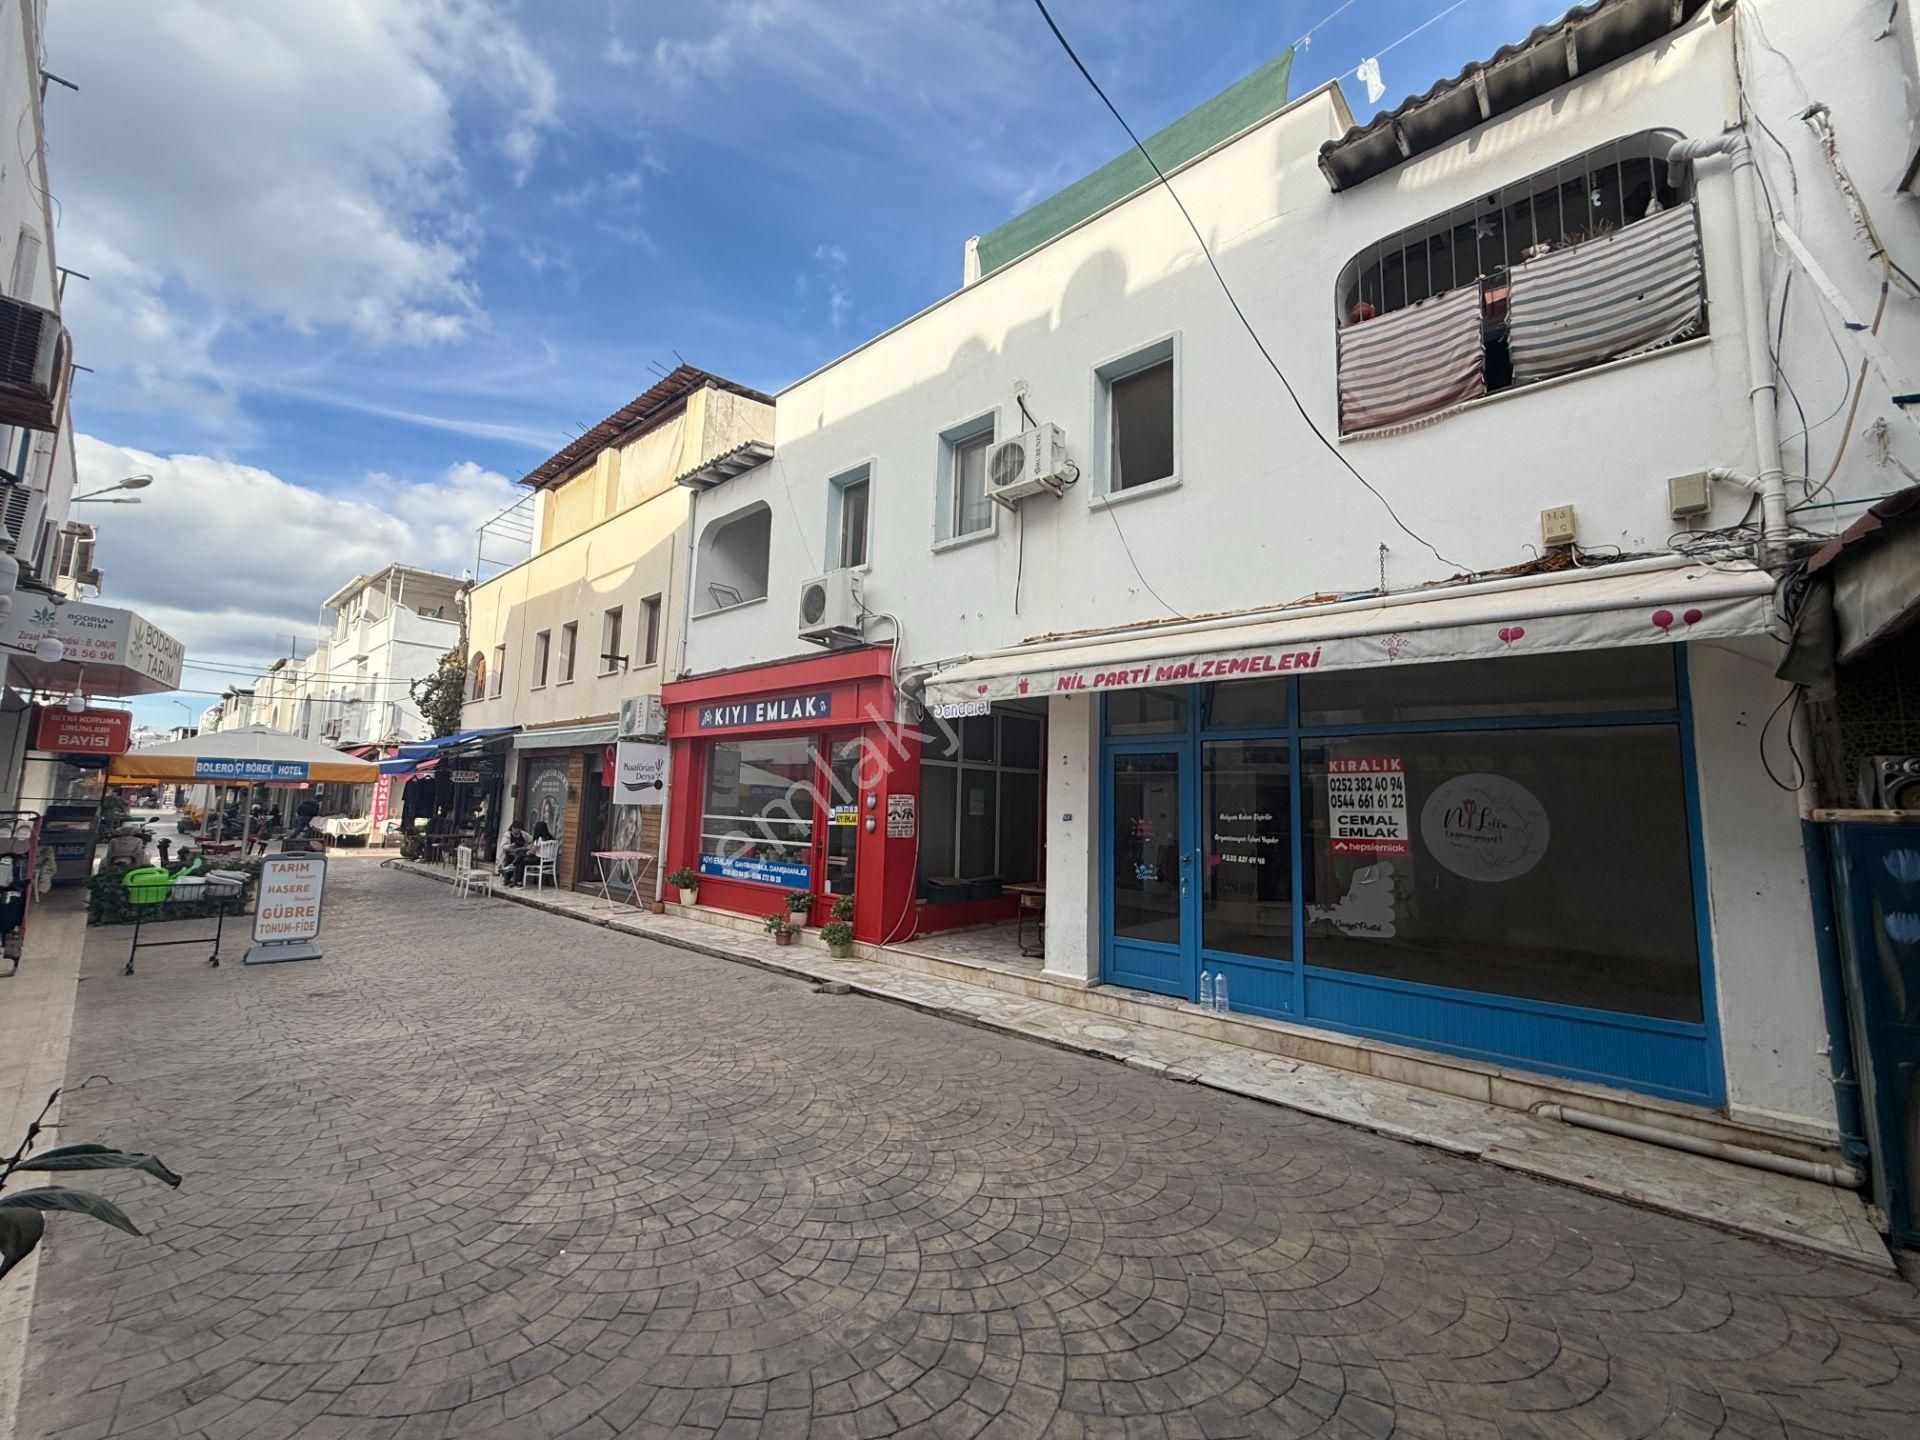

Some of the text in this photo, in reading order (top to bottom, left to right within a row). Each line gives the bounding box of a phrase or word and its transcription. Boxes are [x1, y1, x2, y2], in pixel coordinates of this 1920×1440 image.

[67, 613, 114, 624] BODRUM
[73, 620, 107, 630] TARIM
[95, 640, 117, 649] ONUR
[145, 626, 182, 663] BODRUM
[81, 649, 96, 659] 56
[100, 651, 115, 660] 96
[146, 653, 174, 682] TARIM
[1057, 646, 1321, 691] NİL PARTİ MALZEMELERİ
[715, 696, 816, 726] KIYI EMLAK
[79, 716, 121, 725] KORUMA
[58, 734, 110, 747] BAYİSİ
[196, 762, 234, 773] BOLERO
[246, 762, 272, 774] BÖREK
[278, 765, 303, 776] HOTEL
[1330, 777, 1402, 792] 0252 382 40 94
[1331, 794, 1404, 808] 0544 661 61 22
[1338, 815, 1398, 826] CEMAL
[1338, 827, 1399, 838] EMLAK
[1349, 842, 1405, 853] hepsiemlak
[271, 863, 309, 873] TARIM
[262, 905, 315, 920] GÜBRE
[259, 919, 315, 934] TOHUM-FİDE
